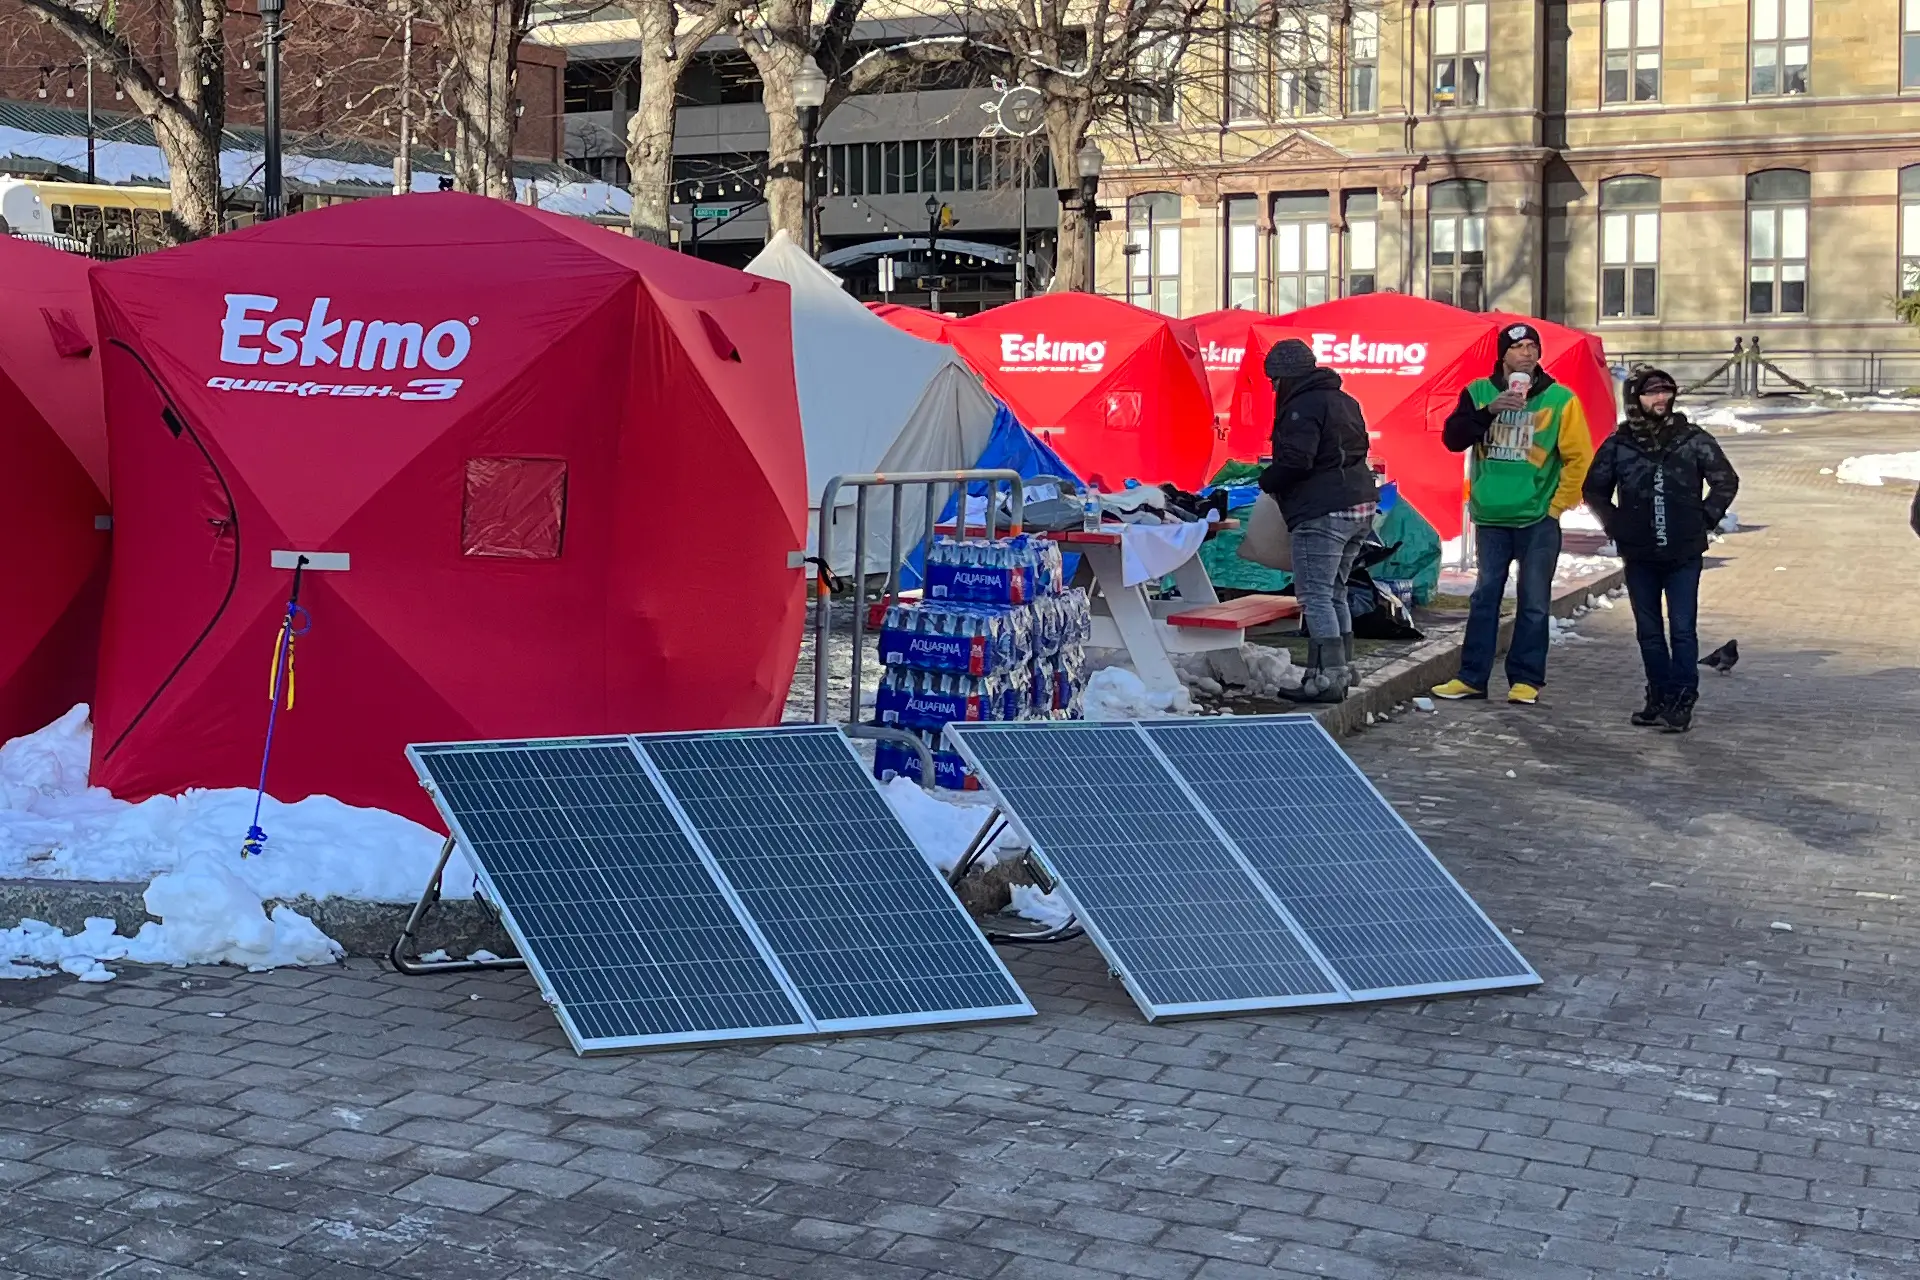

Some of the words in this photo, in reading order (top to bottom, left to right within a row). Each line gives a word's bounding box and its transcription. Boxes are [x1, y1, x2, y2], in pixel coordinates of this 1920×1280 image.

[220, 293, 472, 371] Eskimo
[1000, 333, 1104, 362] Eskimo
[1200, 341, 1246, 363] skim
[1311, 333, 1426, 364] Eskimo
[399, 378, 464, 400] 3
[1654, 495, 1668, 546] UNDER
[953, 571, 1003, 588] AQUAFINA
[909, 639, 961, 657] AQUAFINA
[905, 698, 957, 718] AQUAFINA
[904, 757, 956, 777] AQFINA
